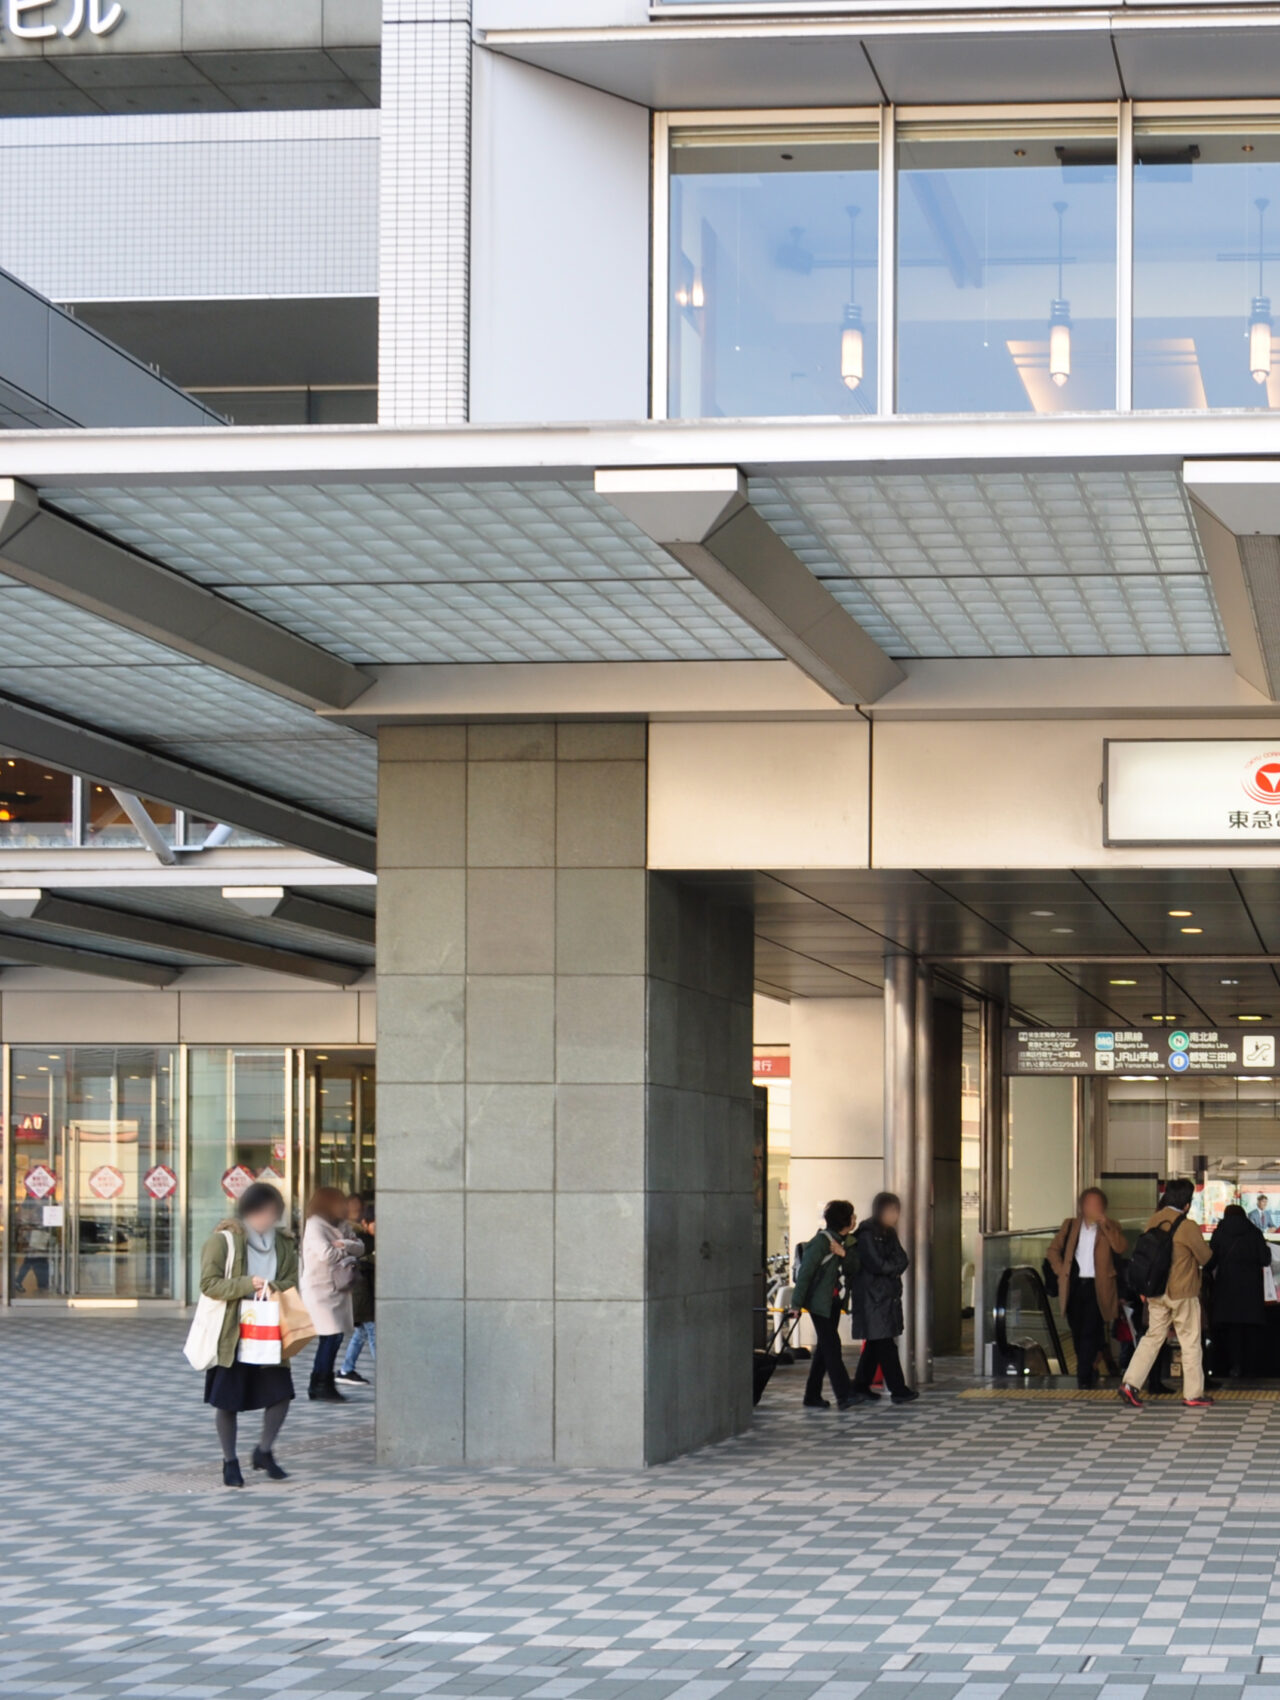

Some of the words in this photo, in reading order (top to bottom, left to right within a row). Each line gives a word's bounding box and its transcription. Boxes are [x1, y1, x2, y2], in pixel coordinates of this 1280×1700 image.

[1115, 1032, 1143, 1042] 目黒線
[1189, 1032, 1218, 1042] 南北線
[1115, 1052, 1159, 1063] JR山手線
